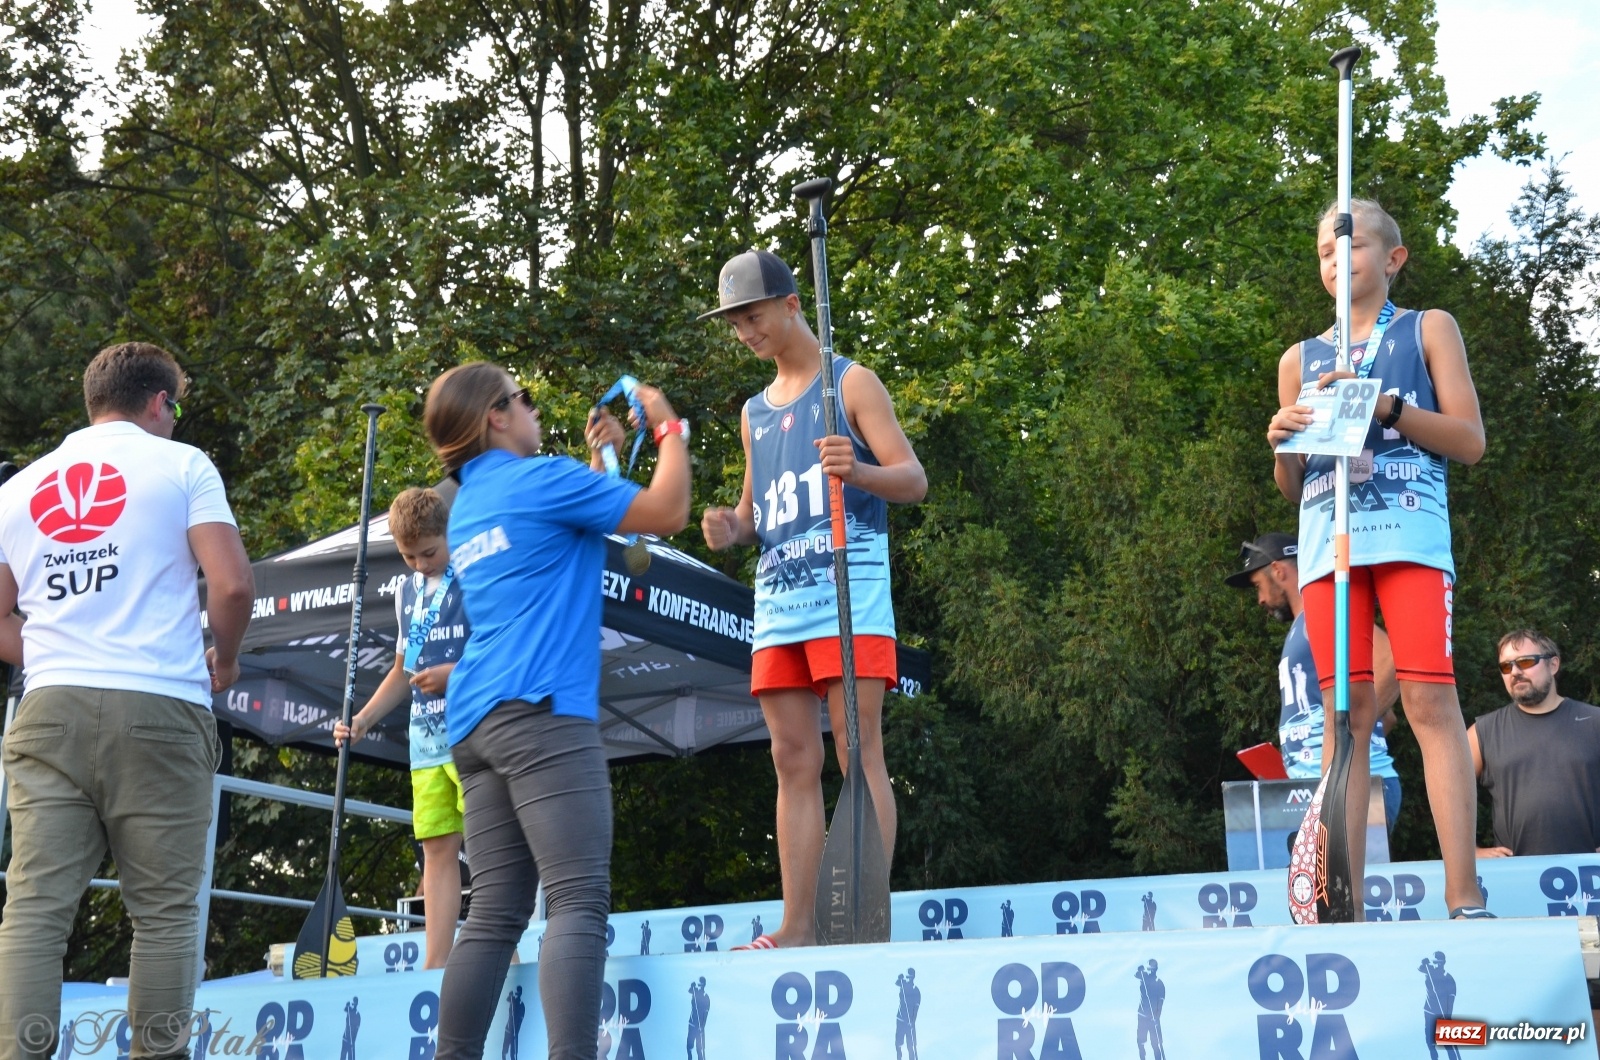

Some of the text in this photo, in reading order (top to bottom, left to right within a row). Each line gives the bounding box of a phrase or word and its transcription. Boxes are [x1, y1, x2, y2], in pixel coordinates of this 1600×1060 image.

[1342, 383, 1375, 401] OD
[1338, 402, 1366, 419] RA
[1385, 462, 1421, 481] CUP
[765, 463, 824, 532] 131
[1352, 522, 1401, 533] MARINA
[43, 543, 119, 568] Związek
[782, 539, 811, 562] SUP
[814, 534, 835, 555] CU
[47, 564, 119, 601] SUP
[352, 596, 363, 641] MARINA
[788, 599, 831, 612] MARINA
[1289, 725, 1312, 742] CUP
[1052, 889, 1107, 921] OD
[1198, 881, 1258, 914] OD
[1363, 873, 1426, 907] OD
[681, 914, 724, 941] OD
[918, 898, 969, 928] OD
[384, 941, 419, 966] OD
[772, 970, 854, 1021] OD
[991, 961, 1087, 1016] OD
[1248, 952, 1361, 1012] OD
[256, 1000, 315, 1042] OD
